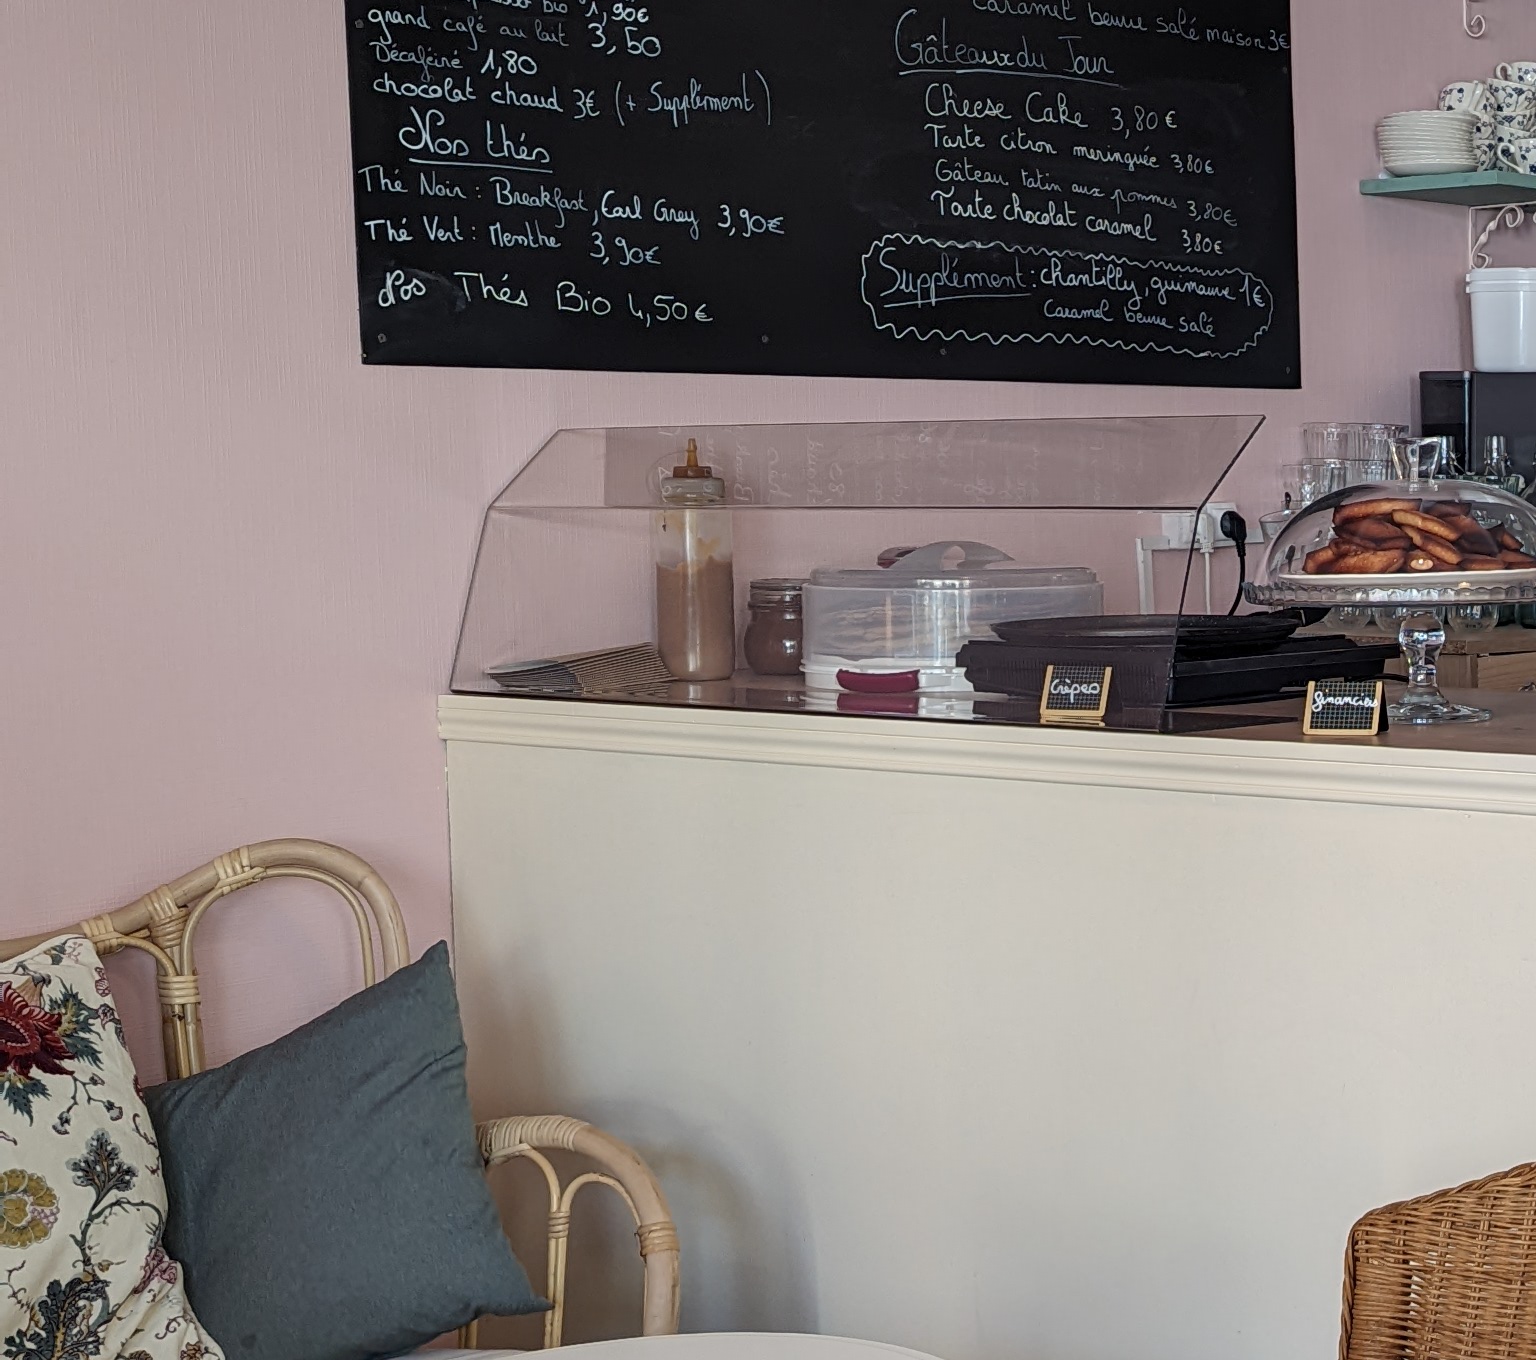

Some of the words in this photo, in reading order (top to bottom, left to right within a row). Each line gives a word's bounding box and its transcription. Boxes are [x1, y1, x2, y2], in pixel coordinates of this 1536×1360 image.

[367, 5, 430, 43] grand
[443, 16, 487, 51] café
[499, 26, 526, 37] au
[535, 19, 569, 46] lait
[588, 23, 662, 57] 3,50
[895, 8, 1015, 67] Gâteaux
[1017, 36, 1047, 70] du
[1058, 36, 1114, 74] Jour
[1088, 2, 1147, 31] beurre
[1156, 9, 1199, 40] salé
[1206, 28, 1266, 49] maison
[374, 41, 464, 82] Décaféiné
[481, 48, 538, 79] 1,80
[372, 71, 477, 102] chocolat
[491, 85, 563, 113] chaud
[924, 83, 1012, 120] Cheese
[1026, 91, 1088, 128] Cake
[398, 106, 469, 156] Nos
[486, 119, 550, 164] thés
[924, 123, 985, 150] Tarte
[1000, 128, 1057, 155] citron
[1073, 145, 1159, 172] meringuée
[1171, 155, 1215, 175] 3,80€
[358, 165, 408, 197] Thé
[601, 189, 642, 221] Earl
[653, 198, 700, 240] Grey
[717, 204, 785, 237] 3,90€
[931, 186, 997, 221] Tarte
[1004, 193, 1077, 228] chocolat
[935, 158, 1008, 186] Gâteau
[1021, 169, 1062, 193] tatin
[1072, 183, 1105, 198] aux
[1111, 188, 1178, 215] pommes
[1187, 201, 1237, 227] 3,80€
[364, 218, 413, 243] Thé
[489, 221, 561, 250] Menthe
[589, 231, 662, 266] 3,90€
[453, 271, 529, 308] Thés
[556, 281, 612, 318] Bio
[1124, 306, 1174, 328] beurre
[1179, 315, 1216, 337] salé
